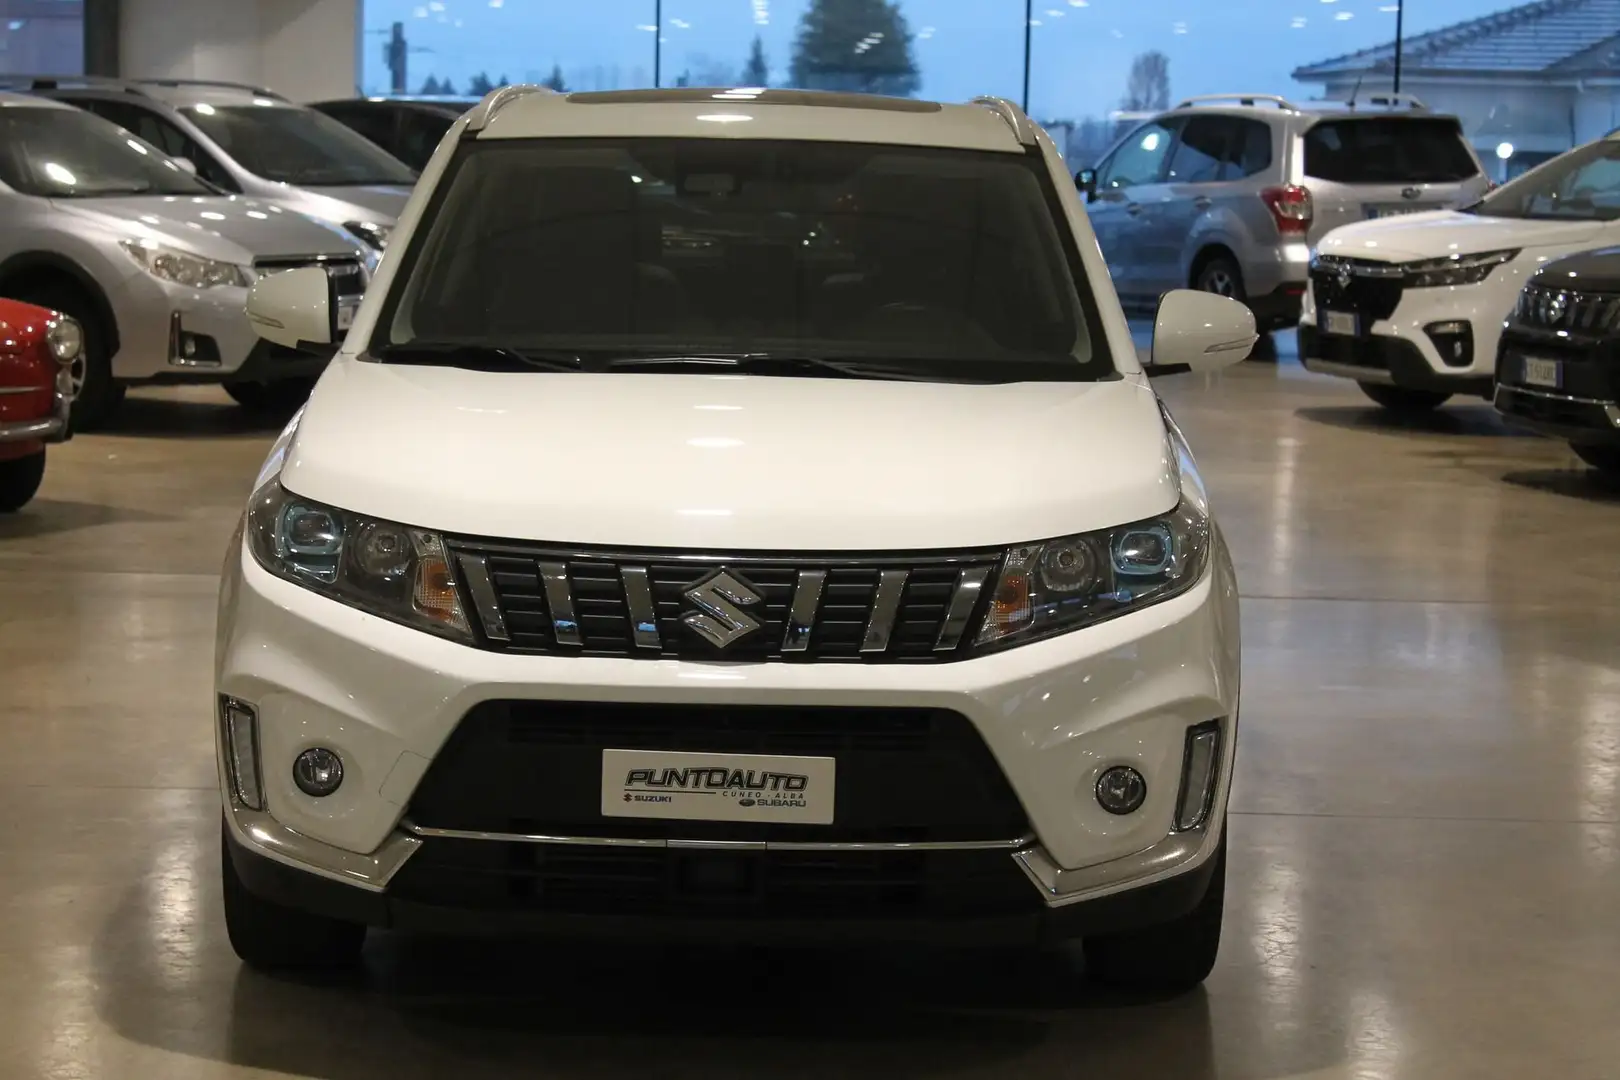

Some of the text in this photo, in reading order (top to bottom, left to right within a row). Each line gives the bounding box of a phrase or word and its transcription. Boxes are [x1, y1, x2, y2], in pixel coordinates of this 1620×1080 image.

[624, 766, 809, 791] PUNTOAUTO
[634, 795, 673, 803] SUZUKI
[722, 790, 762, 799] CUNEO
[757, 798, 807, 807] SUBARU
